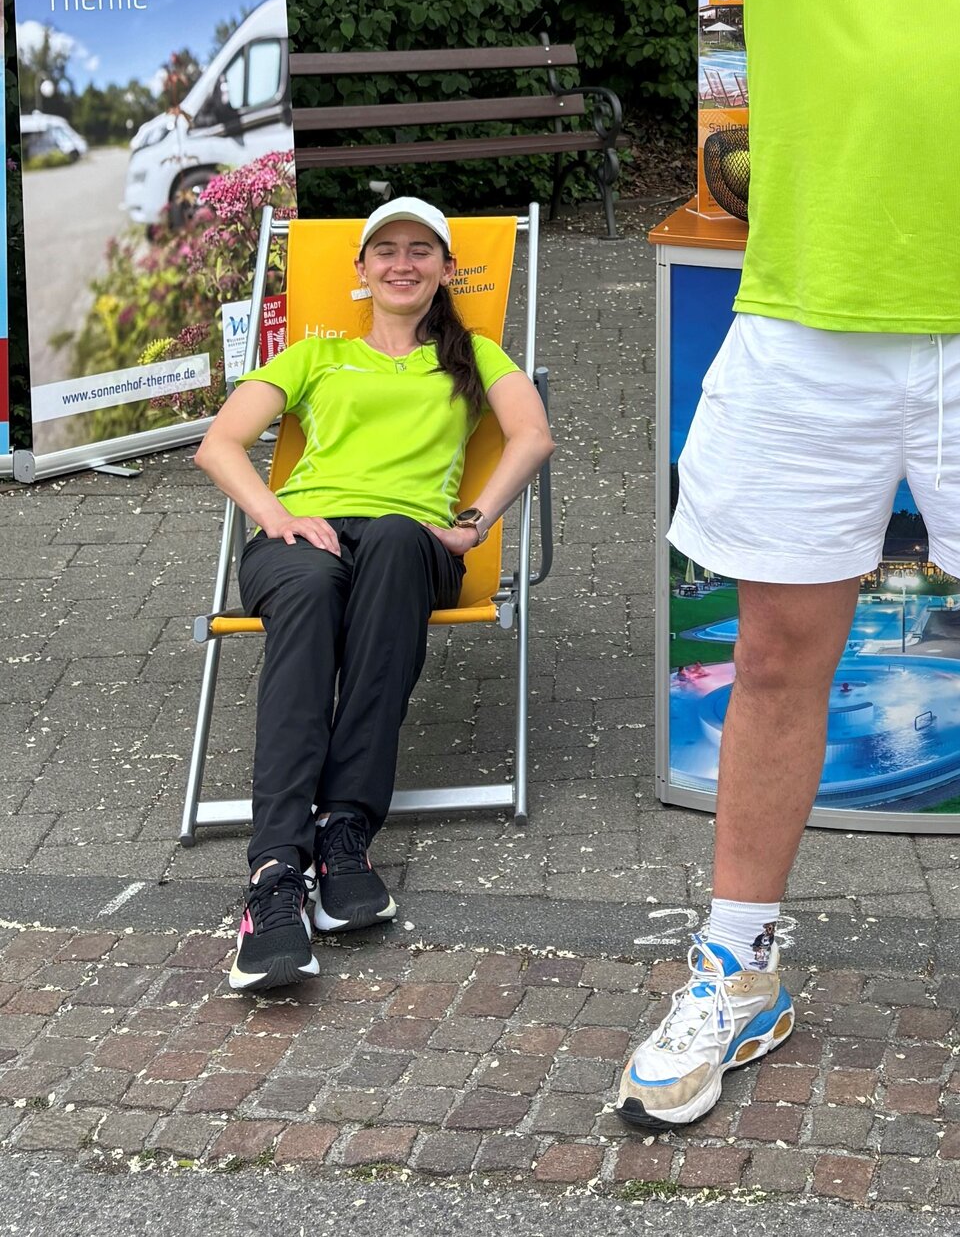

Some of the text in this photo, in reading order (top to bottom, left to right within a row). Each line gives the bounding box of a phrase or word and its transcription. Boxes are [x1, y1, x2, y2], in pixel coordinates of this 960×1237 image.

[453, 283, 495, 295] SAULGAU
[263, 301, 281, 311] STADT
[263, 310, 276, 319] BAD
[305, 323, 348, 339] Hier
[62, 367, 195, 405] www.sonnenhof-therme.de
